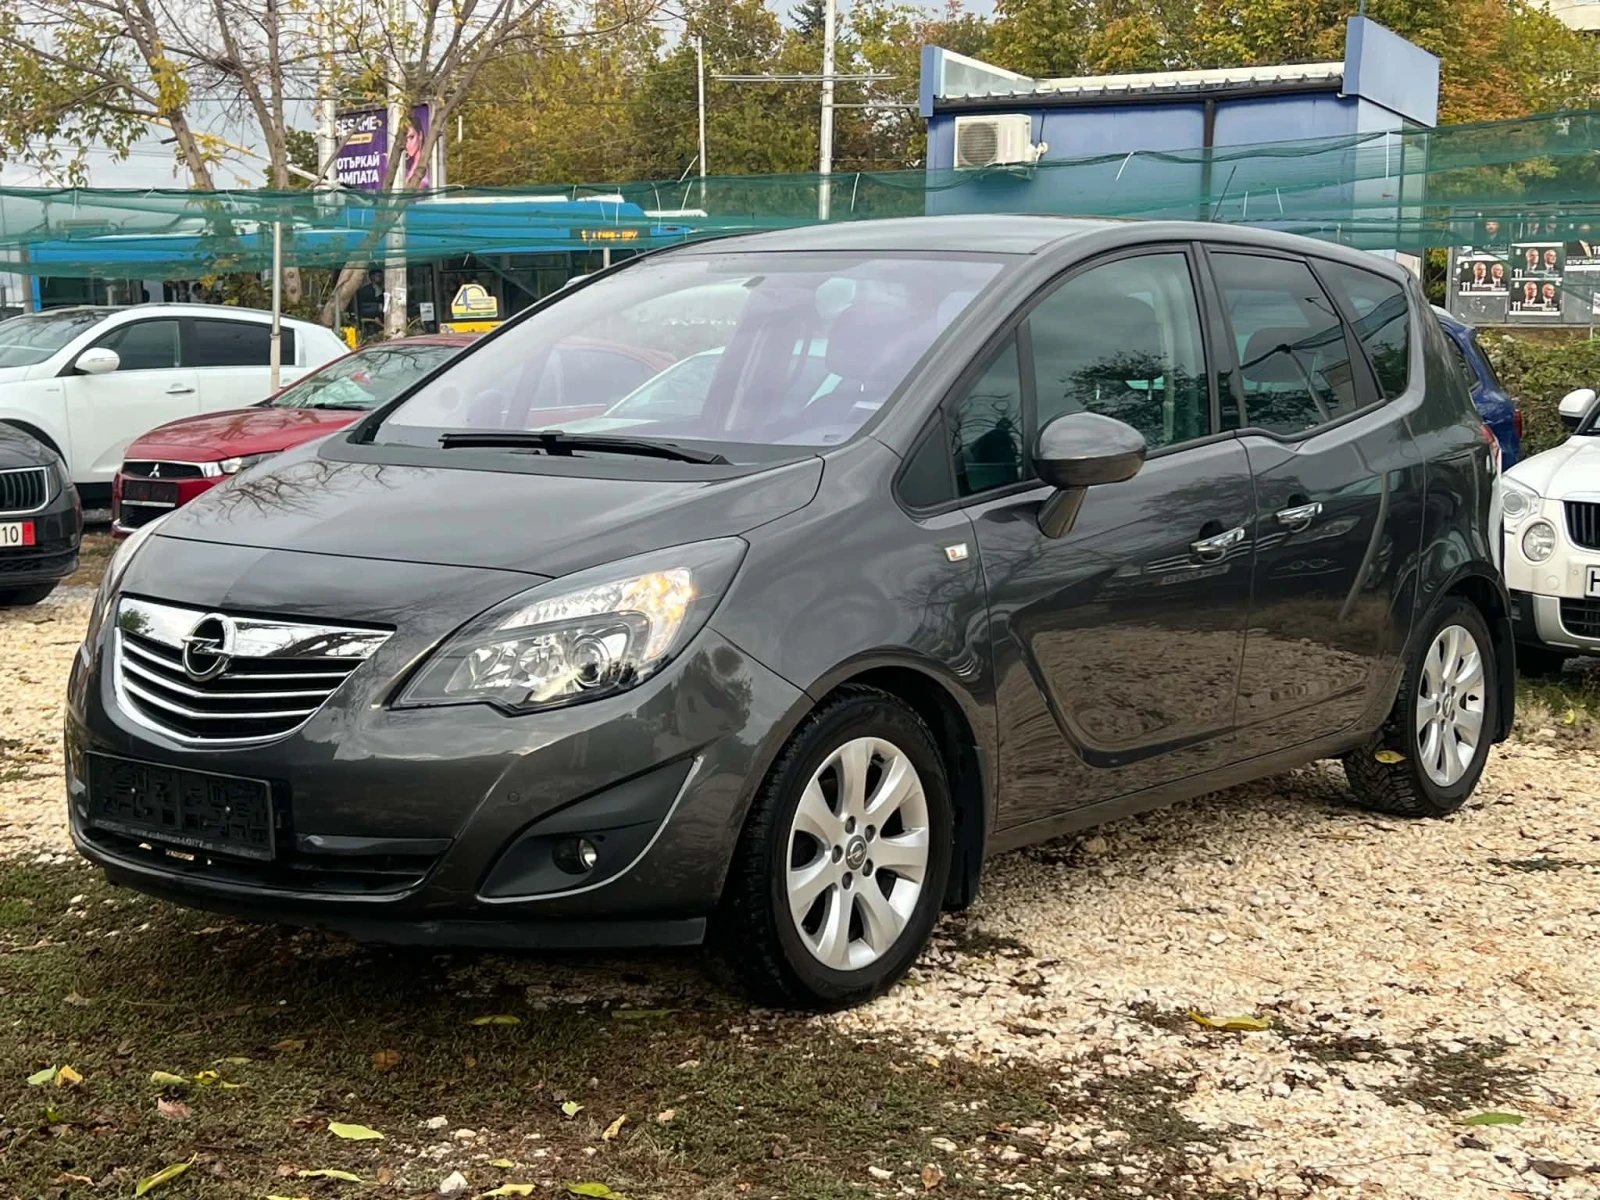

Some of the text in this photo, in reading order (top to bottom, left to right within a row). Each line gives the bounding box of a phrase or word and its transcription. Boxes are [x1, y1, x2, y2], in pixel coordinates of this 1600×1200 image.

[337, 151, 380, 170] ОТЪРКАЙ
[338, 170, 379, 185] АМПАТА
[1461, 281, 1471, 291] 11
[1511, 301, 1521, 311] 11
[2, 526, 19, 543] 10
